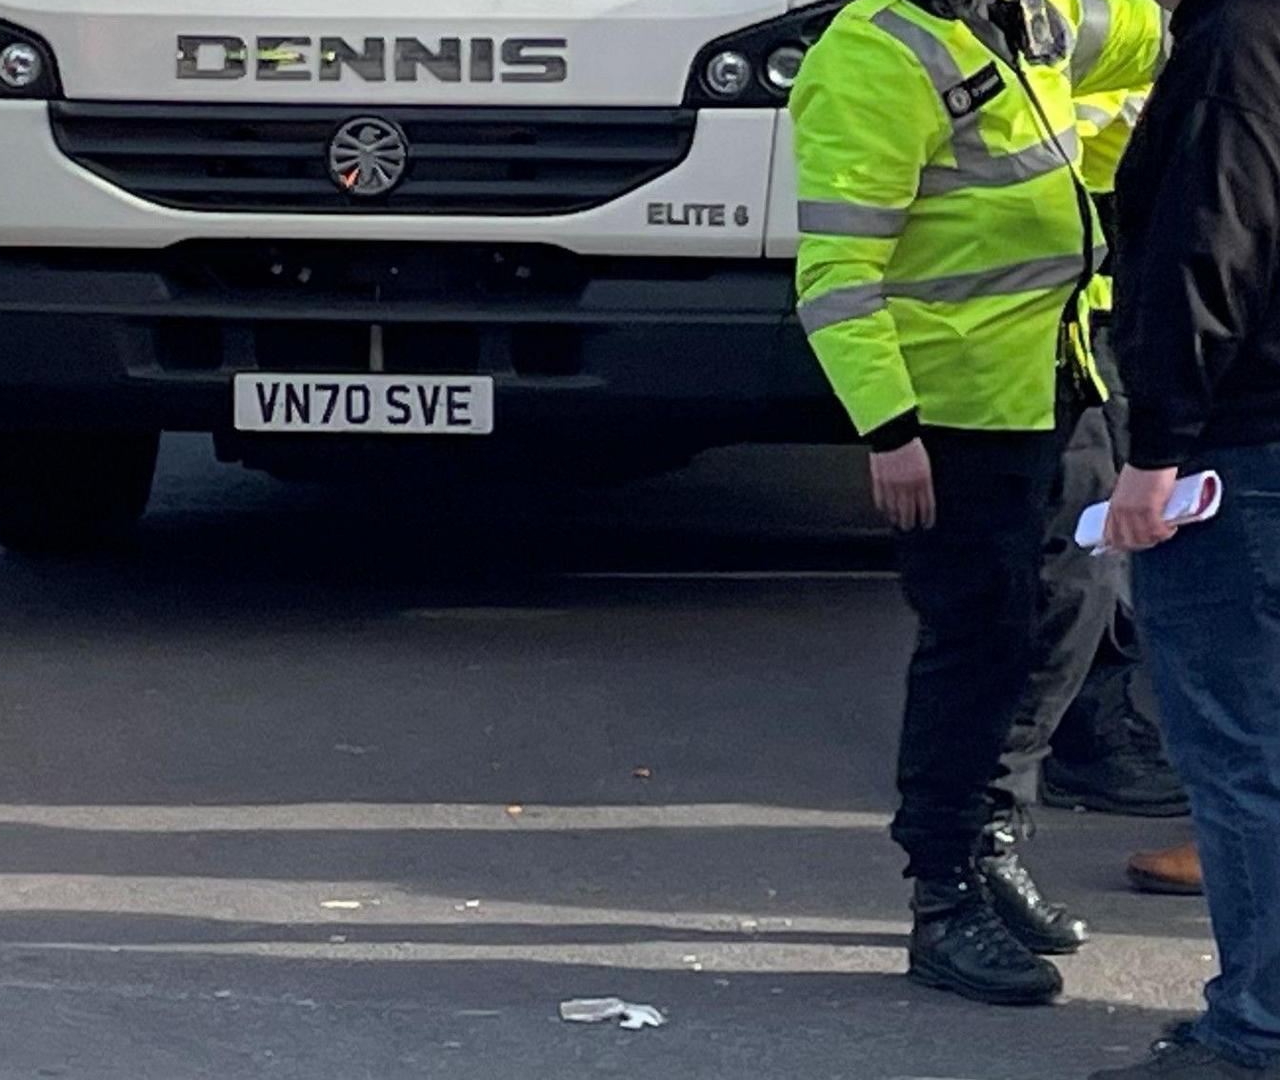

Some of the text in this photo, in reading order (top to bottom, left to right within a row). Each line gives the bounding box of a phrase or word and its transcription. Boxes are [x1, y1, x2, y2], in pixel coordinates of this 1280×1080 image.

[176, 34, 568, 83] DENNIS
[647, 202, 726, 226] ELITE
[256, 382, 473, 427] VN70 SVE
